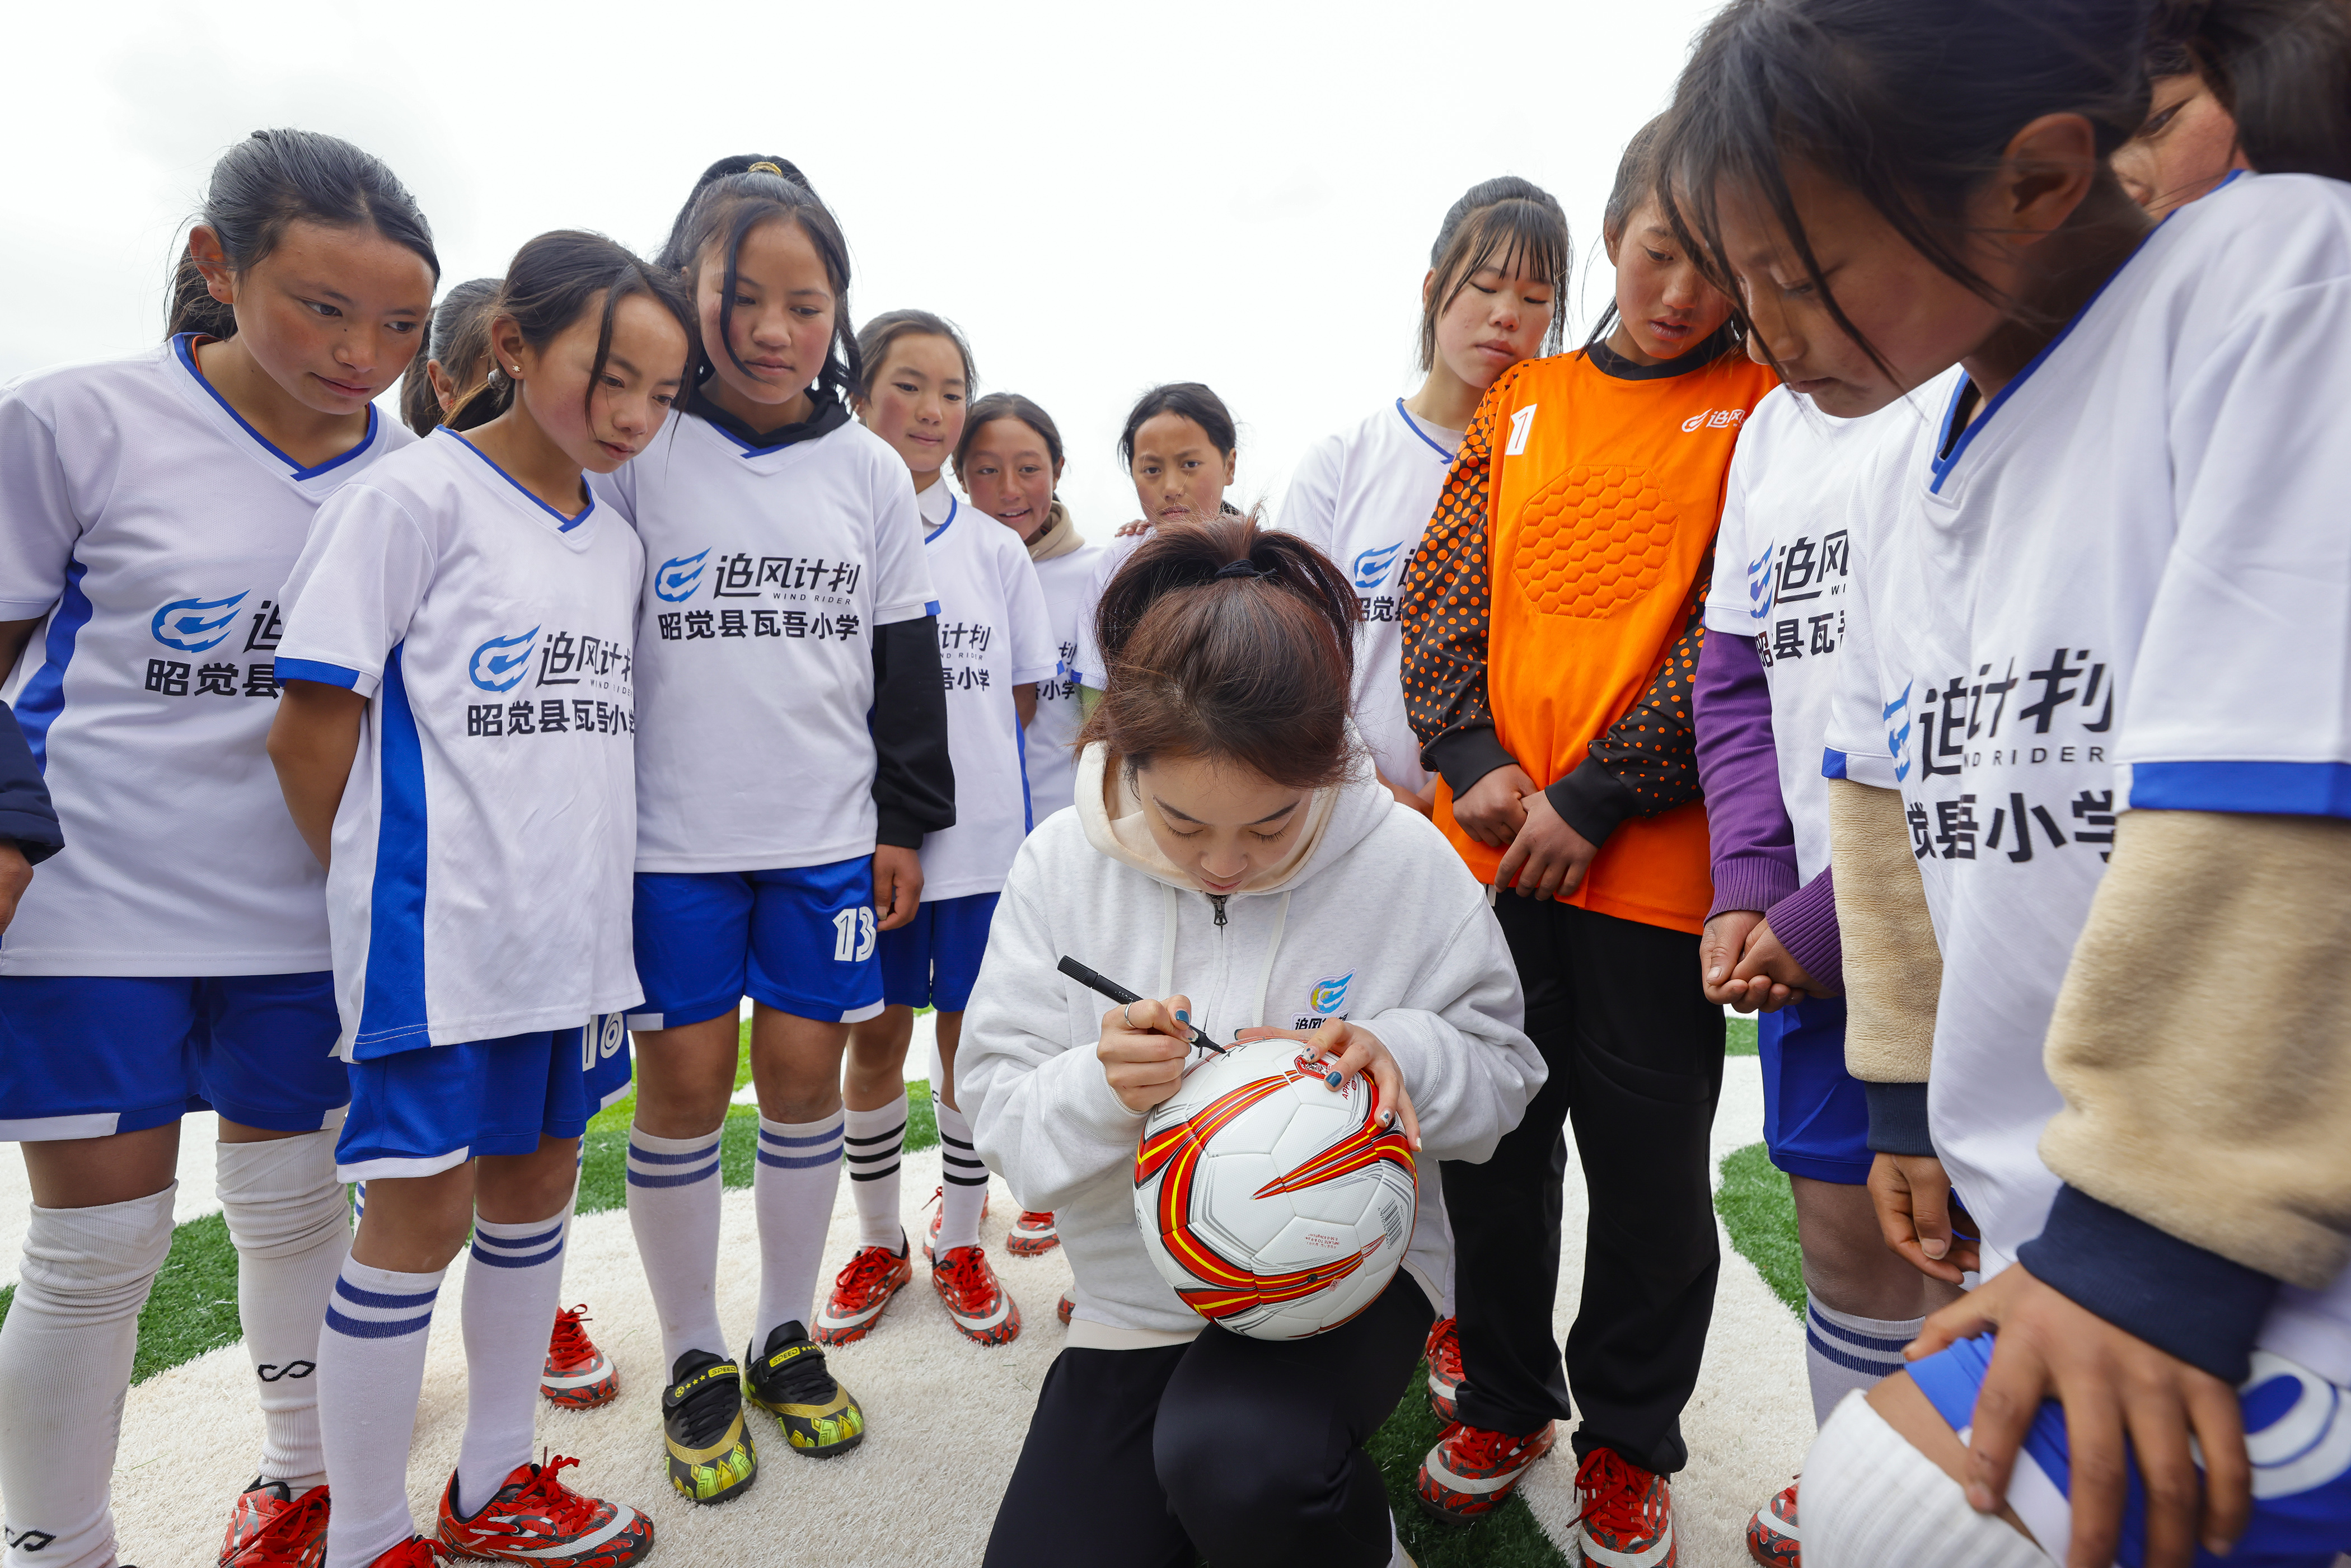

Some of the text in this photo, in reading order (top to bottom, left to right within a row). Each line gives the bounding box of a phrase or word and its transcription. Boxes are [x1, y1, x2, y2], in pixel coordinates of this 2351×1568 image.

[1506, 404, 1537, 455] 1
[1706, 409, 1745, 428] 追风
[713, 553, 861, 600] 追风计划
[773, 592, 851, 605] WIND RIDER
[657, 609, 860, 641] 昭觉县瓦吾小学
[938, 622, 991, 652] 计划
[145, 658, 280, 699] 昭觉县
[590, 678, 609, 690] WIND
[1036, 680, 1075, 700] 小学
[1992, 746, 2105, 766] RIDER
[832, 906, 877, 962] 13
[582, 1012, 624, 1072] 16
[1342, 1078, 1351, 1101] APPR
[772, 1349, 798, 1365] SPEED
[711, 1366, 736, 1375] SPEED
